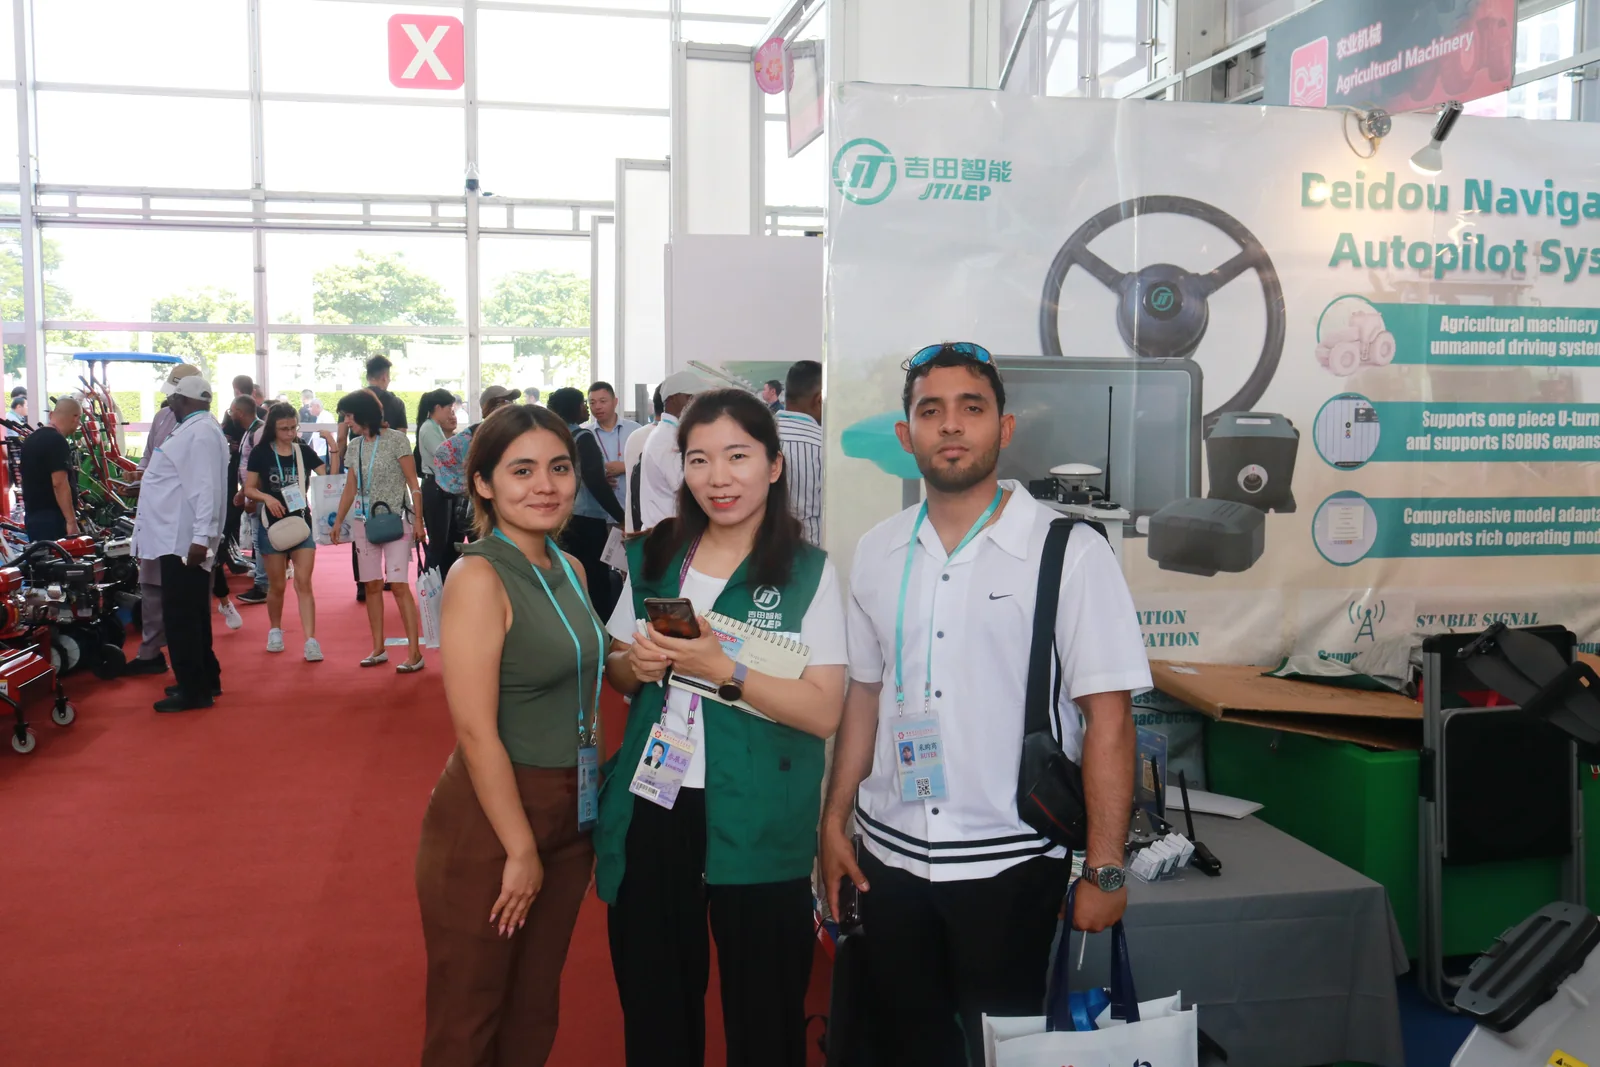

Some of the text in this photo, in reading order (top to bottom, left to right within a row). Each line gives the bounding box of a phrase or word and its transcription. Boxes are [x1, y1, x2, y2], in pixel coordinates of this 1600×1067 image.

[1336, 22, 1382, 59] 农业机械
[401, 24, 452, 80] X
[1336, 31, 1474, 94] Agricultural Machinery
[904, 156, 1012, 183] 吉田智能
[918, 182, 992, 201] JTILEP
[1464, 178, 1600, 226] Naviga
[1328, 232, 1527, 280] Autopilot
[1440, 315, 1598, 335] Agricultural machinery
[1430, 340, 1505, 356] unmanned
[1508, 339, 1556, 357] driving
[1422, 410, 1600, 429] Supports one piece U-turn
[1406, 434, 1430, 450] and
[1433, 434, 1499, 452] supports
[1501, 433, 1549, 450] ISOBUS
[1403, 507, 1511, 525] Comprehensive
[1513, 506, 1555, 523] model
[1410, 531, 1472, 548] supports
[1475, 529, 1502, 546] rich
[1505, 529, 1571, 546] operating
[1416, 612, 1540, 628] STABLE SIGNAL
[1142, 631, 1200, 647] ATION
